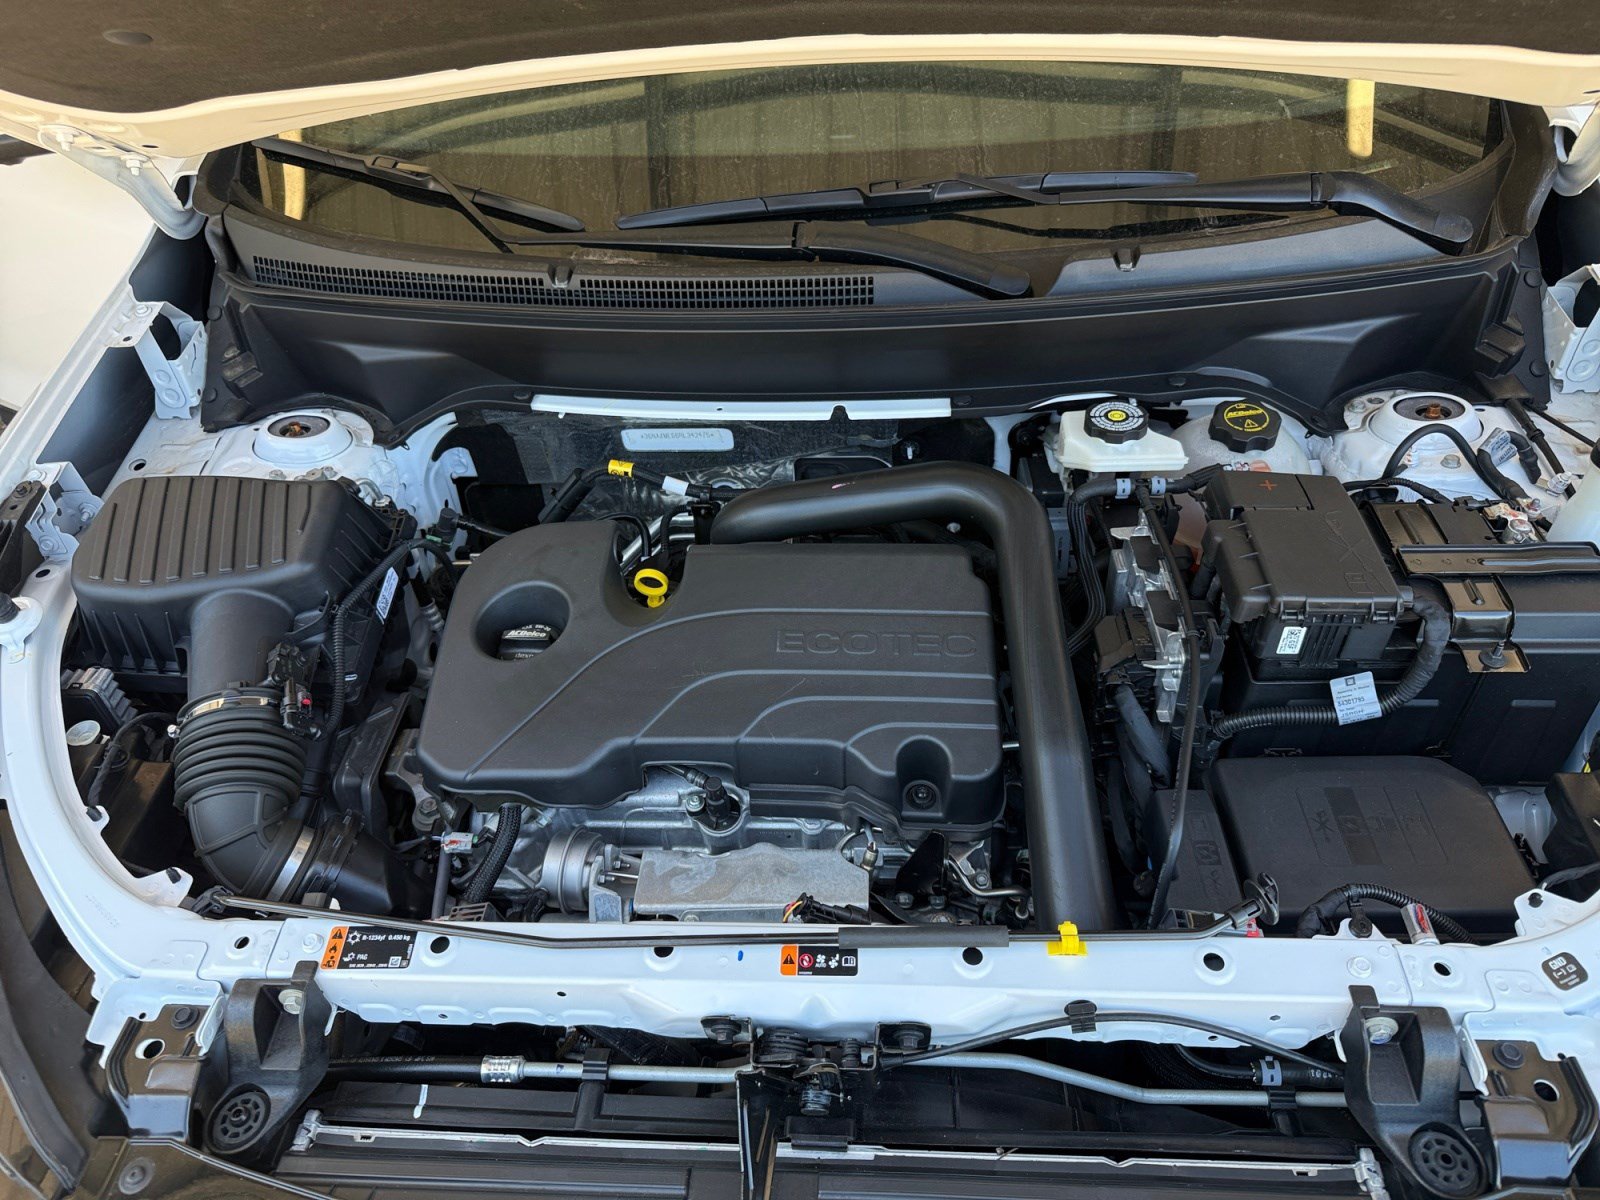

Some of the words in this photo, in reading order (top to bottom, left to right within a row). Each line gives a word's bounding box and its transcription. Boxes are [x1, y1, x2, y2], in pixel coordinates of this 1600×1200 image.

[507, 629, 547, 638] ACDelco
[776, 629, 977, 657] ECOTEC
[402, 934, 411, 942] kg
